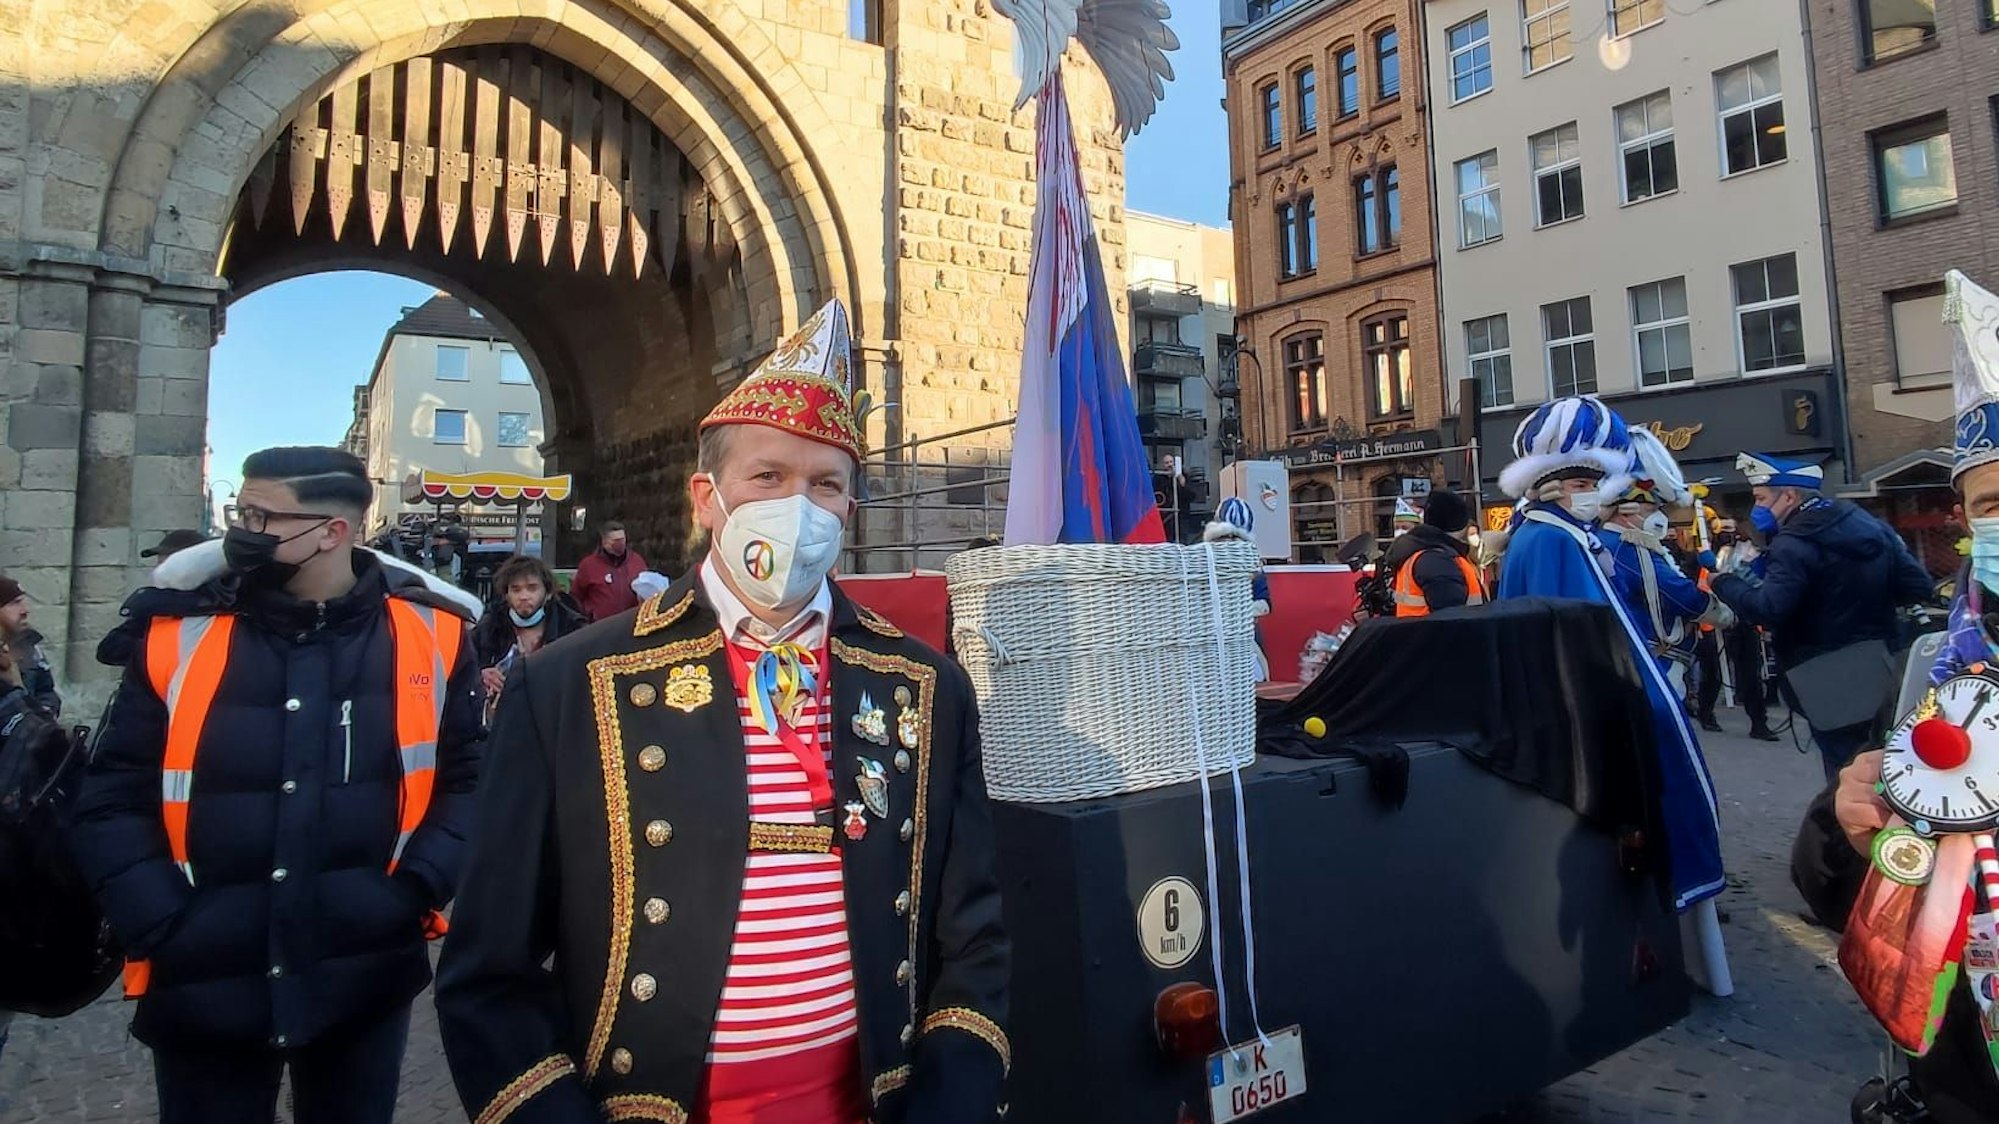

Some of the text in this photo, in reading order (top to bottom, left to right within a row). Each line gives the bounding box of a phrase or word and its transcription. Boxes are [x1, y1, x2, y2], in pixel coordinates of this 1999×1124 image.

[1374, 440, 1425, 457] Hermann
[1983, 717, 1997, 731] 3
[1905, 764, 1914, 776] 9
[1964, 776, 1977, 790] 6
[1164, 889, 1180, 932] 6
[1160, 933, 1186, 954] km/h
[1254, 1045, 1267, 1072] K
[1232, 1070, 1287, 1116] 0650
